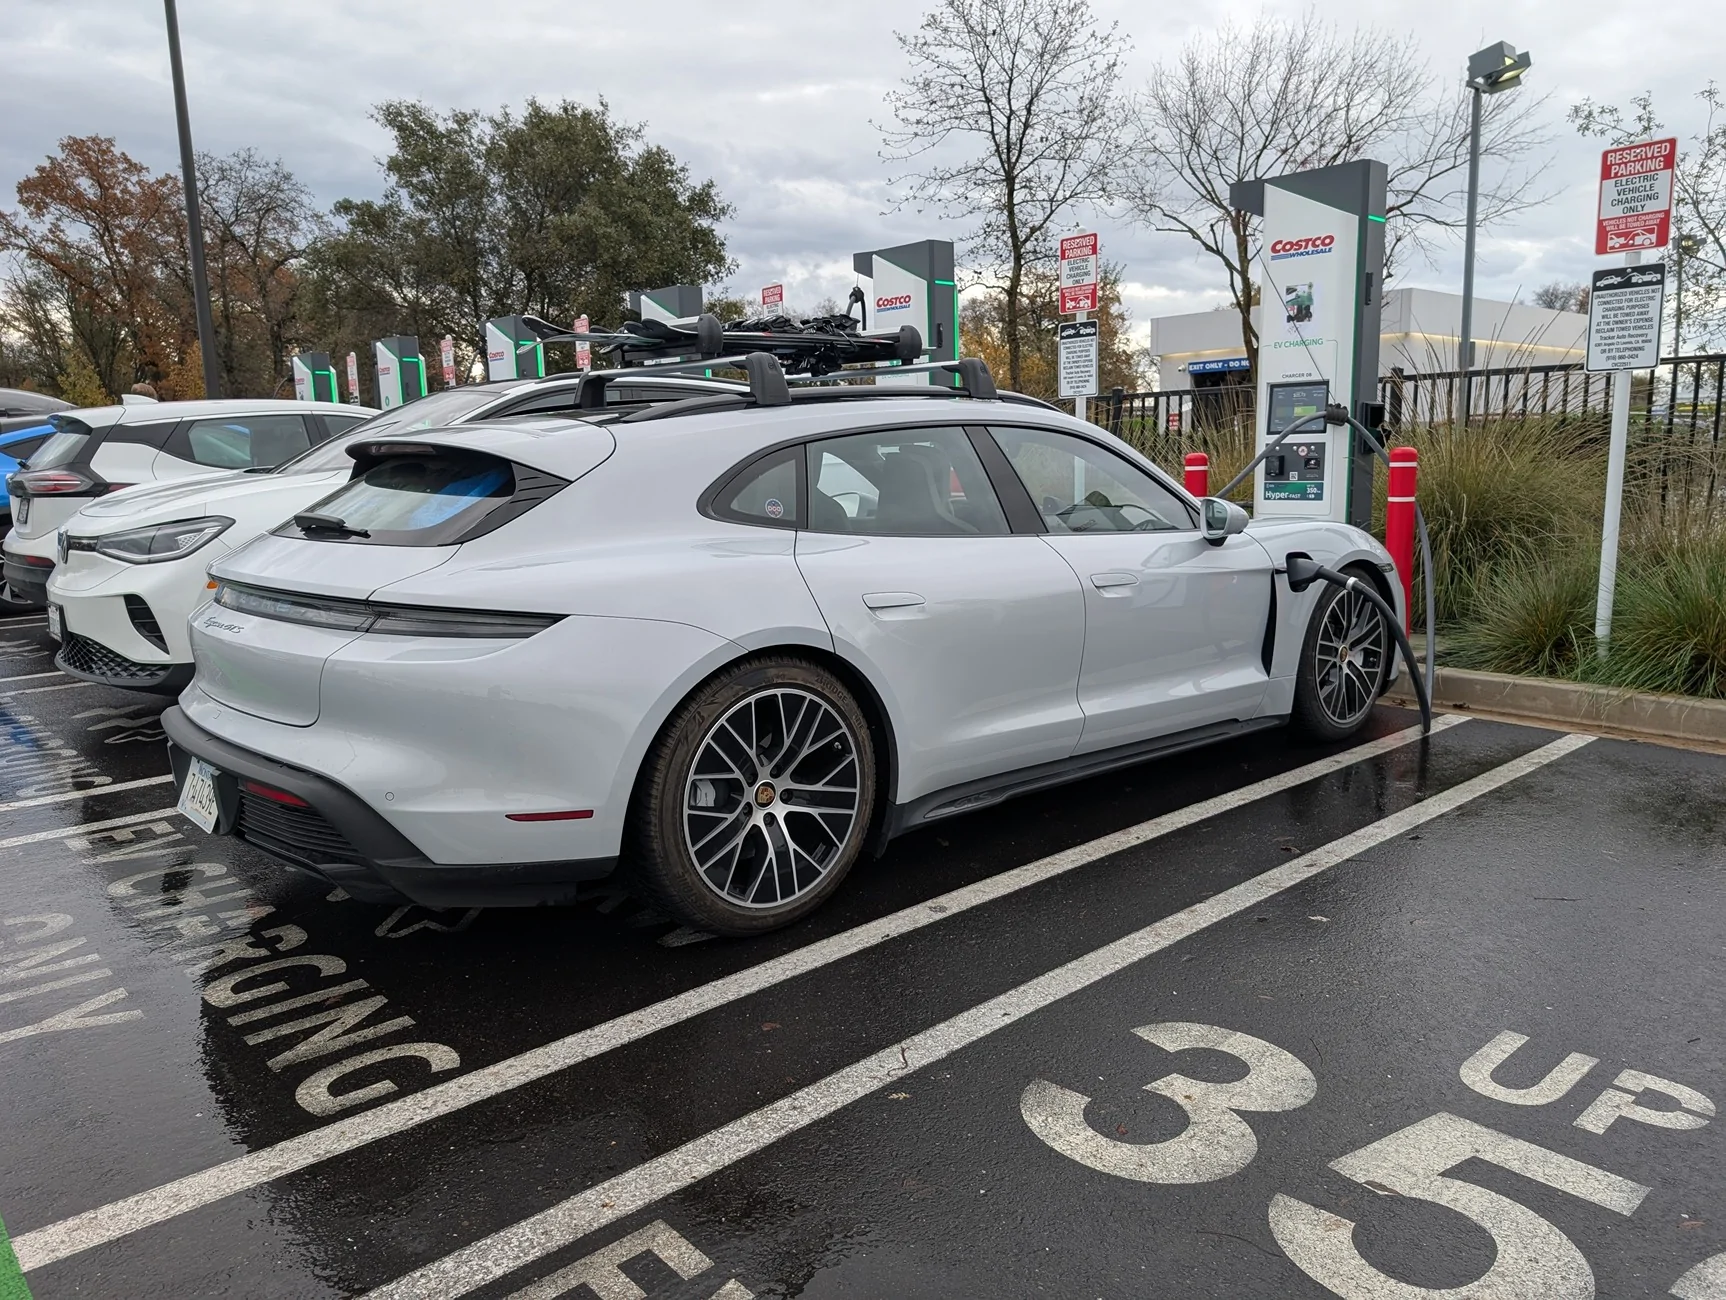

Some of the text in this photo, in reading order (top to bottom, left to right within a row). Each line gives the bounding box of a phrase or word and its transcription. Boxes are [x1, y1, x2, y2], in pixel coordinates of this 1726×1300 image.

[1606, 142, 1670, 165] RESERVED
[1611, 157, 1664, 177] PARKING
[1614, 173, 1659, 188] ELECTRIC
[1616, 183, 1655, 196] VEHICLE
[1610, 192, 1659, 207] CHARGING
[1622, 203, 1646, 214] ONLY
[1602, 218, 1627, 226] VEHICLES
[1638, 212, 1665, 220] CHARGING
[1062, 236, 1095, 250] RESERVED
[1270, 234, 1335, 254] COSTCO
[1065, 246, 1093, 259] PARKING
[1289, 247, 1333, 258] WHOLESALE
[1067, 257, 1090, 266] ELECTRIC
[1068, 264, 1089, 272] VEHICLE
[1066, 270, 1091, 279] CHARGING
[876, 294, 911, 308] COSTCO
[1597, 298, 1623, 306] CONNECTED
[1634, 295, 1656, 303] ELECTRIC
[1284, 338, 1324, 348] CHARGING
[1188, 363, 1204, 371] EXIT
[1205, 362, 1223, 370] ONLY
[64, 820, 461, 1118] EV CHARGING
[1458, 1029, 1717, 1136] UP
[1019, 1021, 1726, 1300] 35
